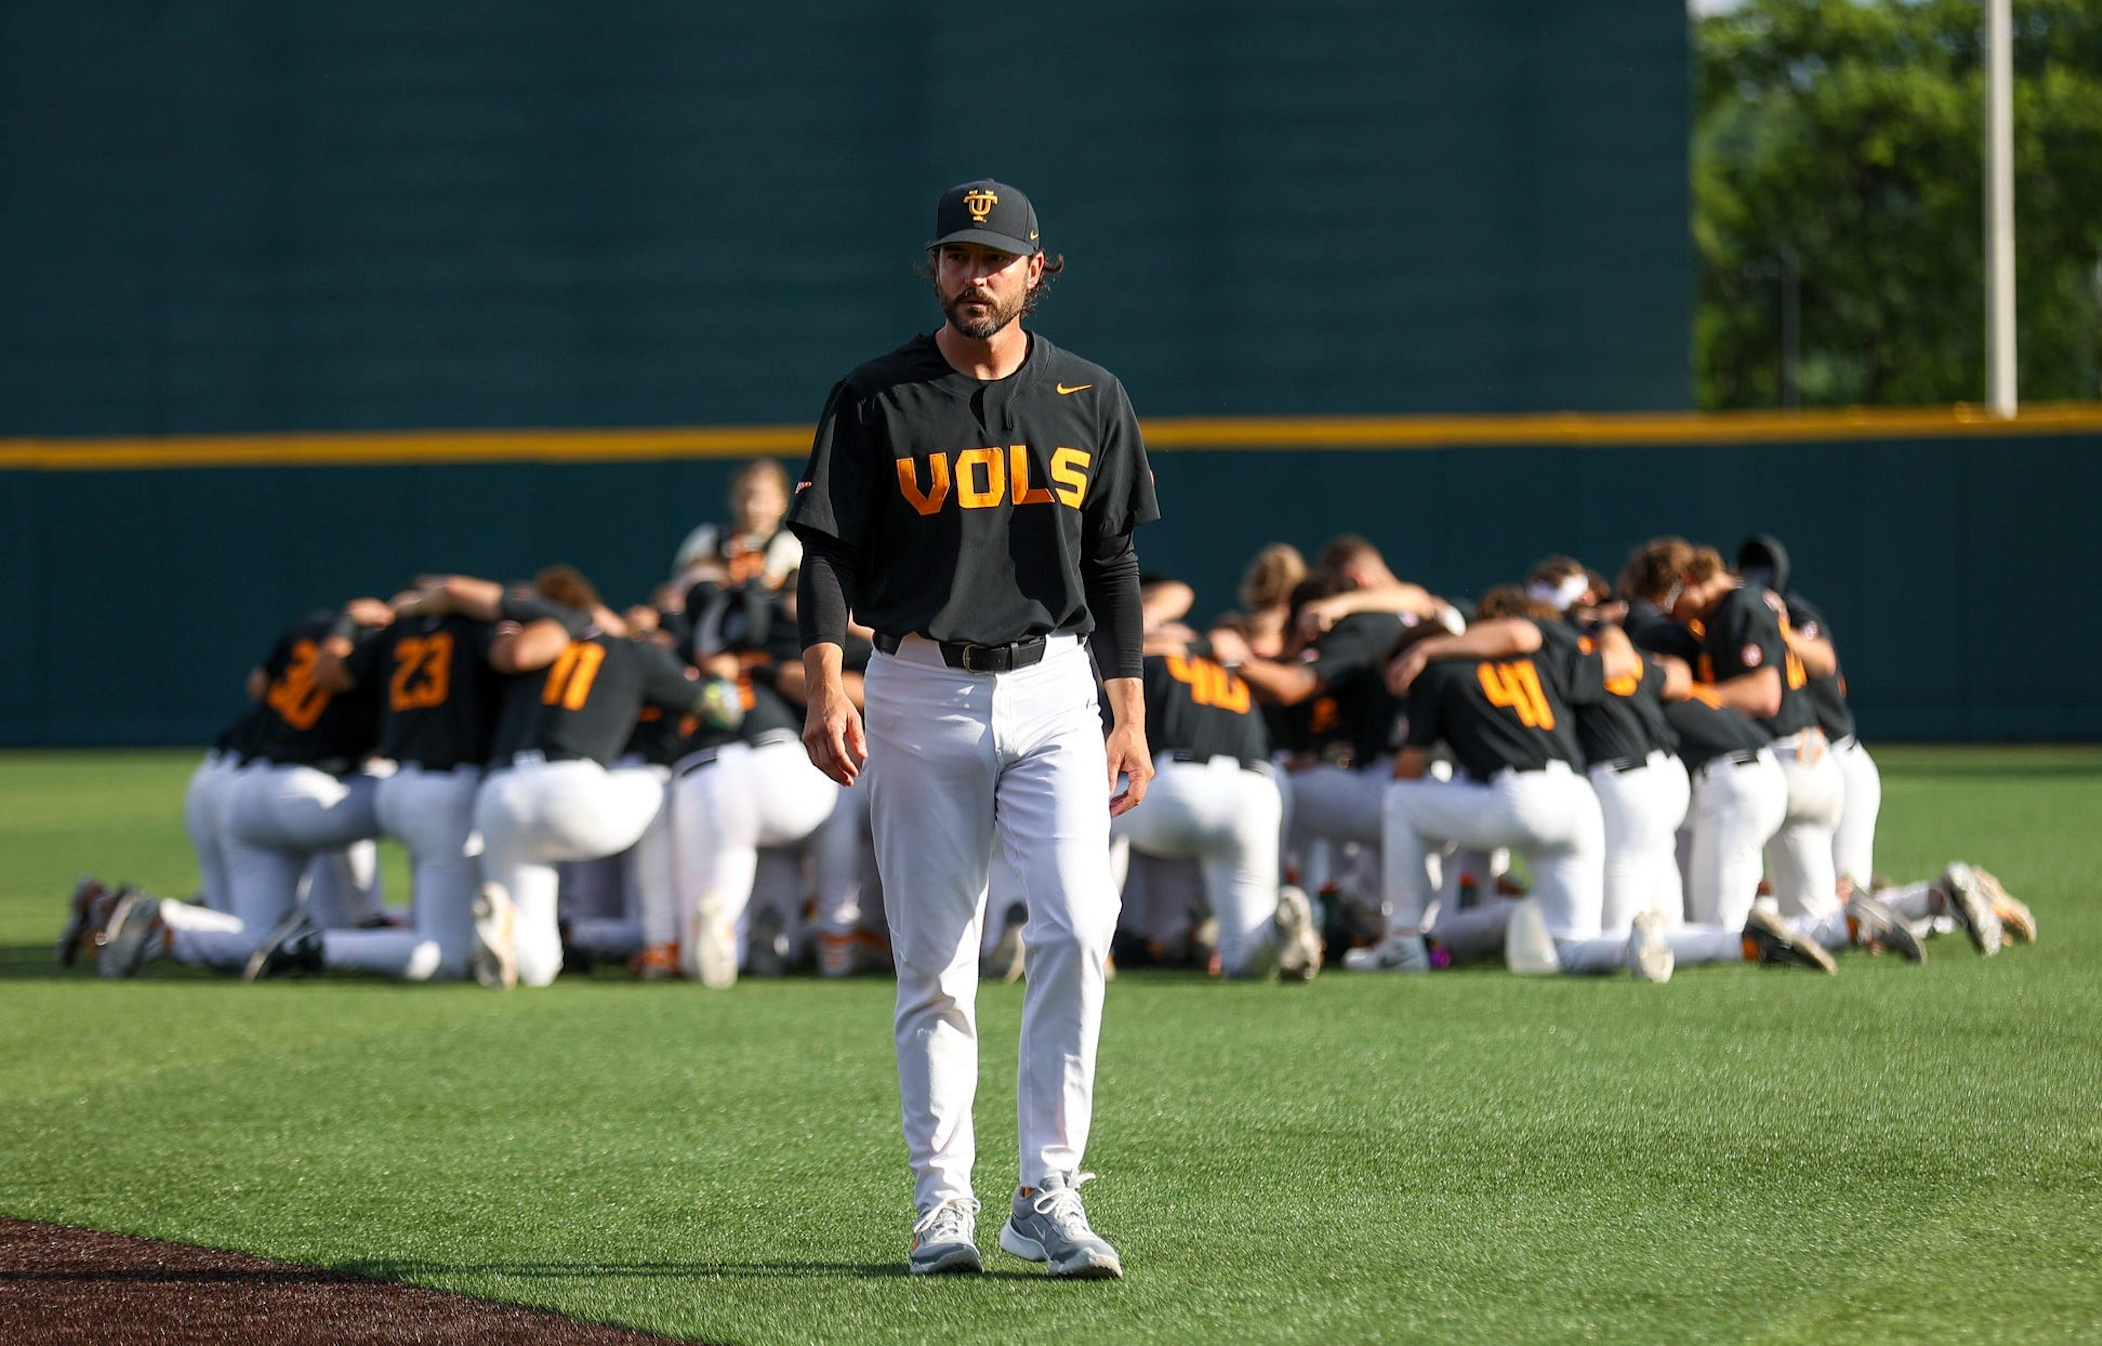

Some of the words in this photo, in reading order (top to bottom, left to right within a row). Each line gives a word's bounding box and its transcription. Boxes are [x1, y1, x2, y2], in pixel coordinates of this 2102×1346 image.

[896, 444, 1092, 516] VOLS
[390, 633, 454, 712] 23
[541, 640, 606, 711] 11
[1477, 658, 1556, 731] 41
